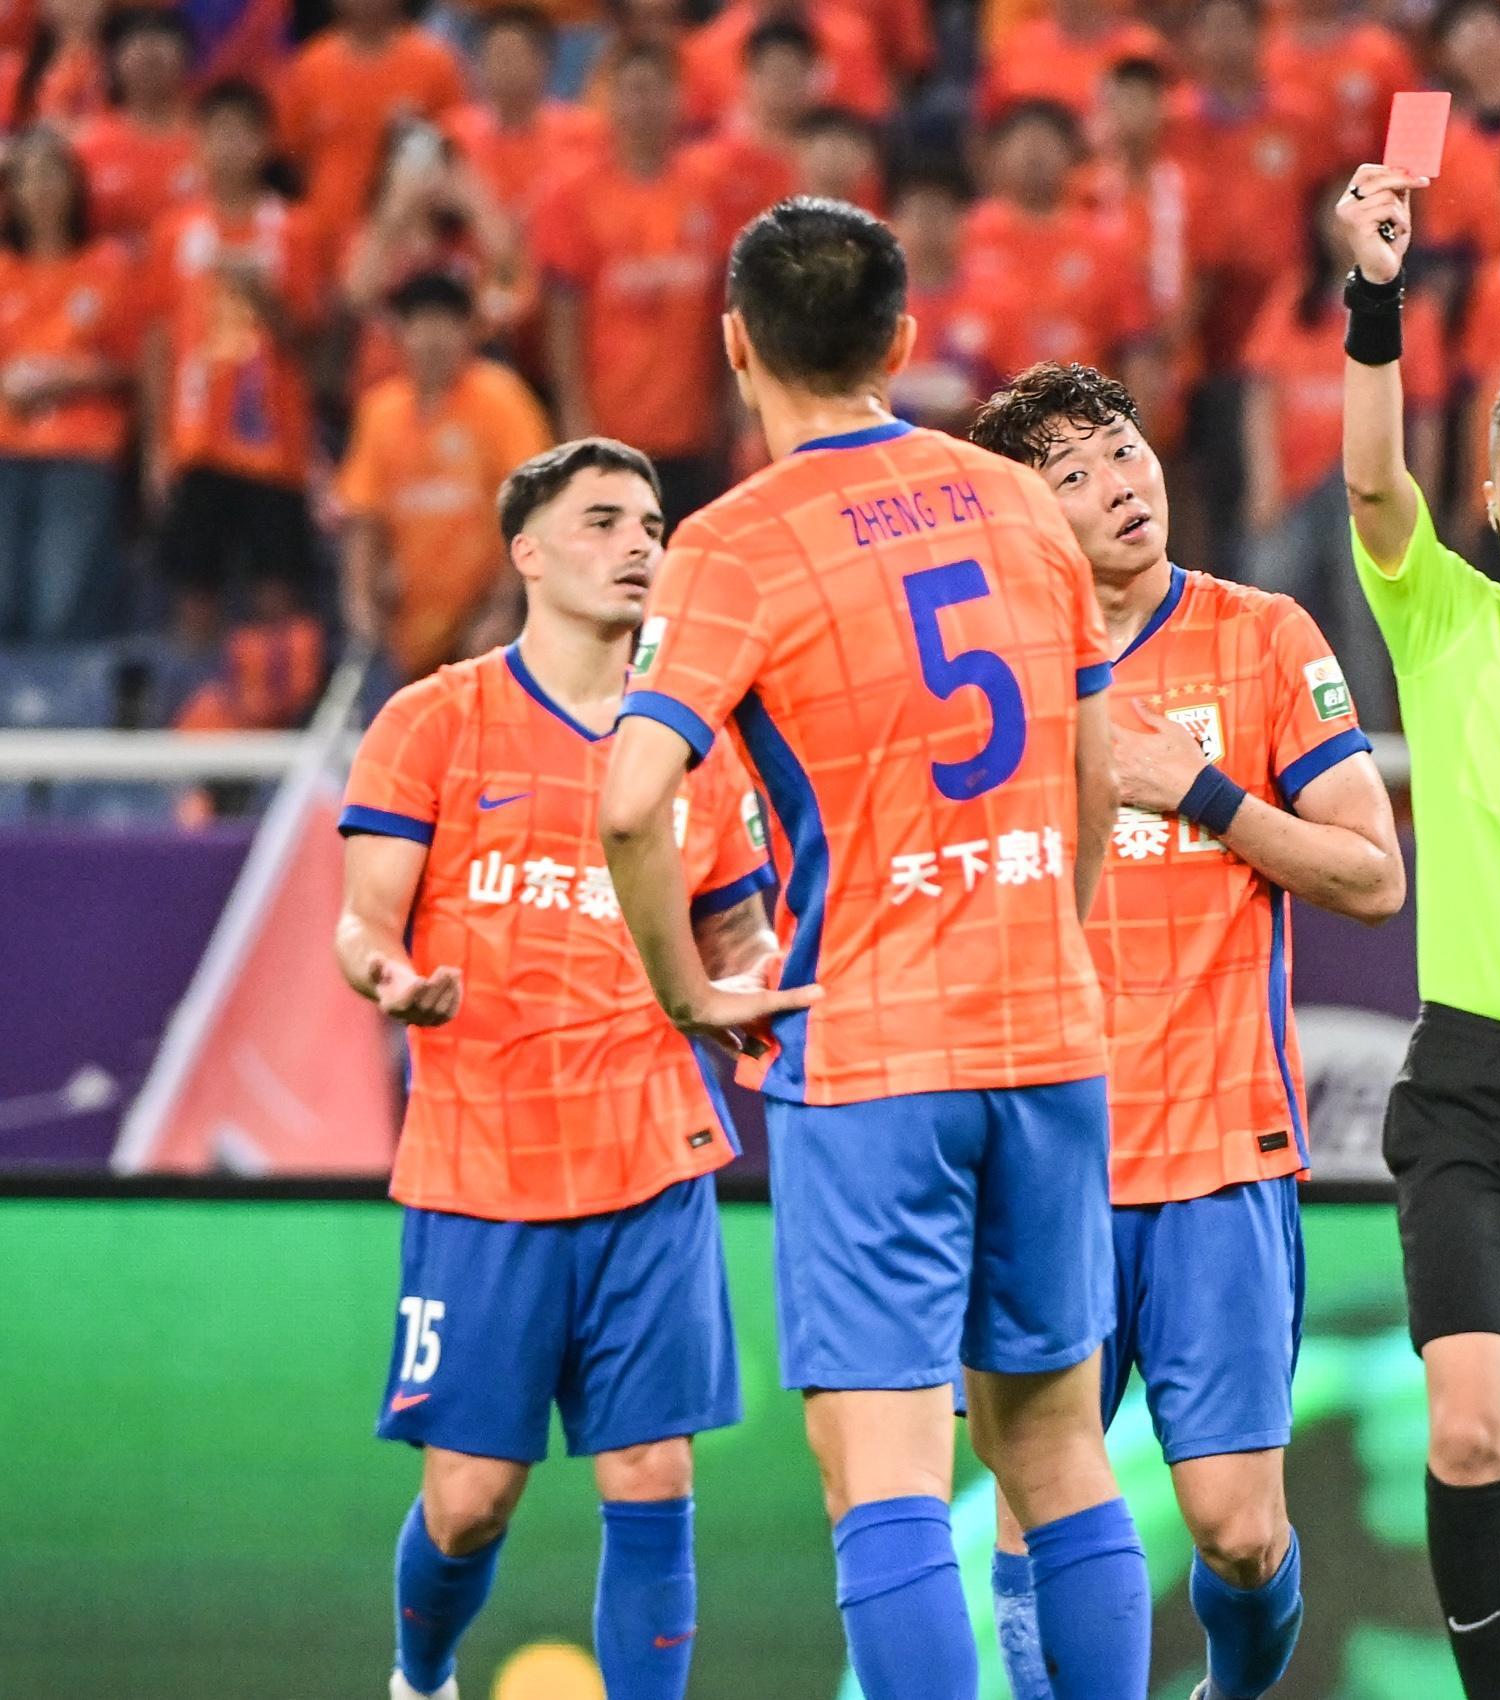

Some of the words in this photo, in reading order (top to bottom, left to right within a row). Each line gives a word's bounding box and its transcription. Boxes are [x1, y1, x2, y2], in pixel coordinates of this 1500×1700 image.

[841, 492, 936, 546] ZHENG
[941, 480, 996, 523] ZH.
[903, 559, 1027, 801] 5
[468, 850, 619, 920] 山东泰
[399, 1297, 445, 1384] 15
